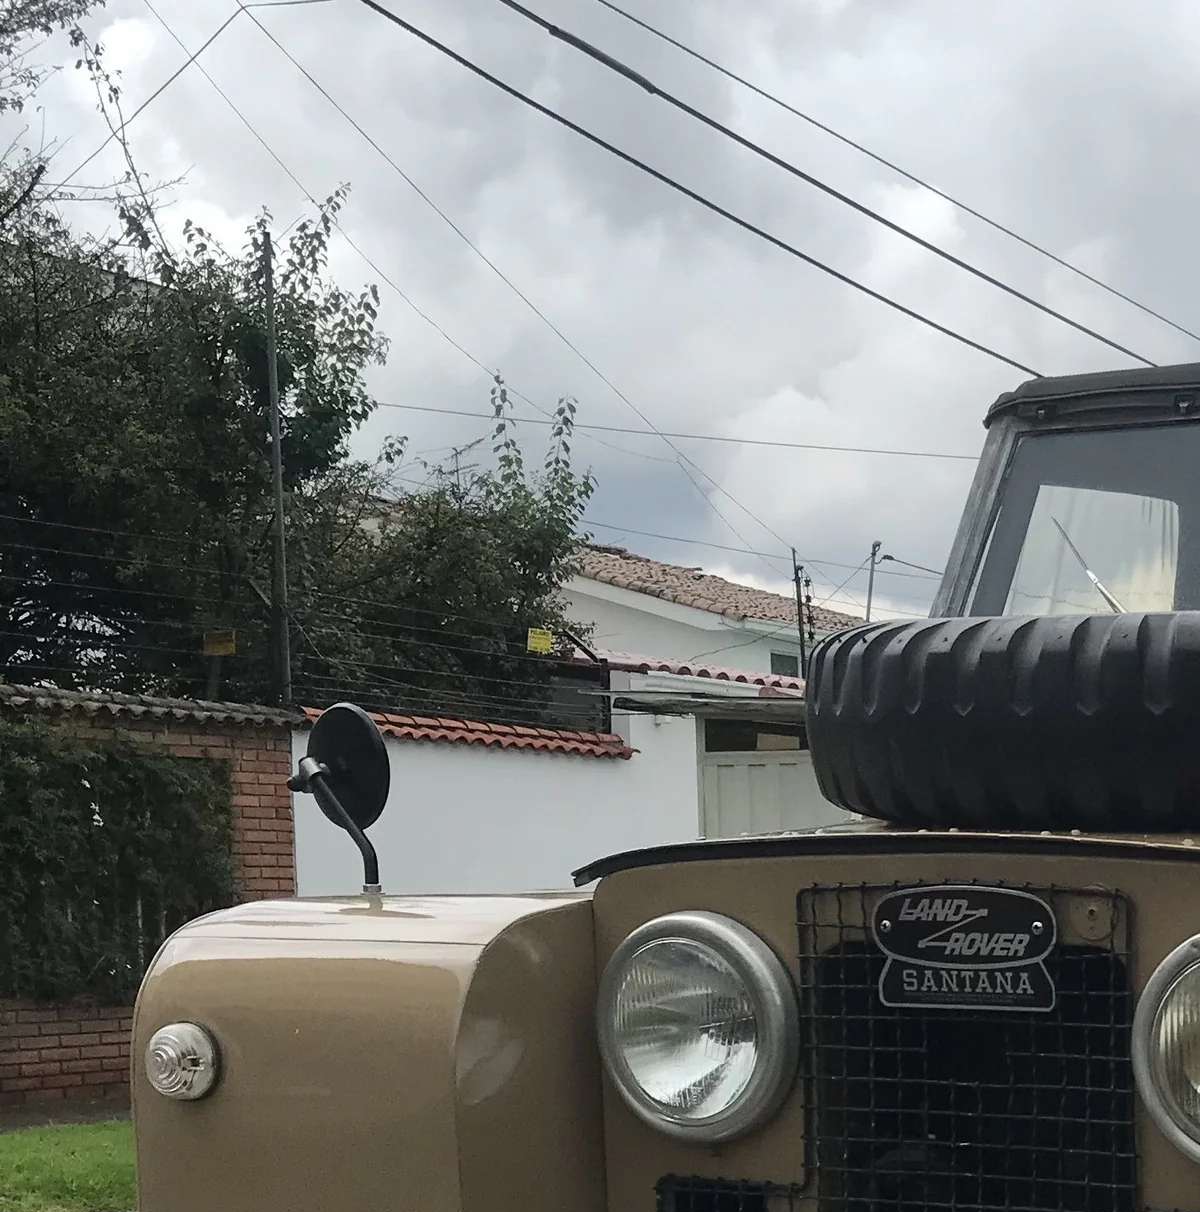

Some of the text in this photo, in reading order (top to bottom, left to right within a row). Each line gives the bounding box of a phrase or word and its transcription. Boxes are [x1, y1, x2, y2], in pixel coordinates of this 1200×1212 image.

[899, 899, 969, 922] LAND
[944, 932, 1030, 957] ROVER
[903, 969, 1035, 994] SANTANA
